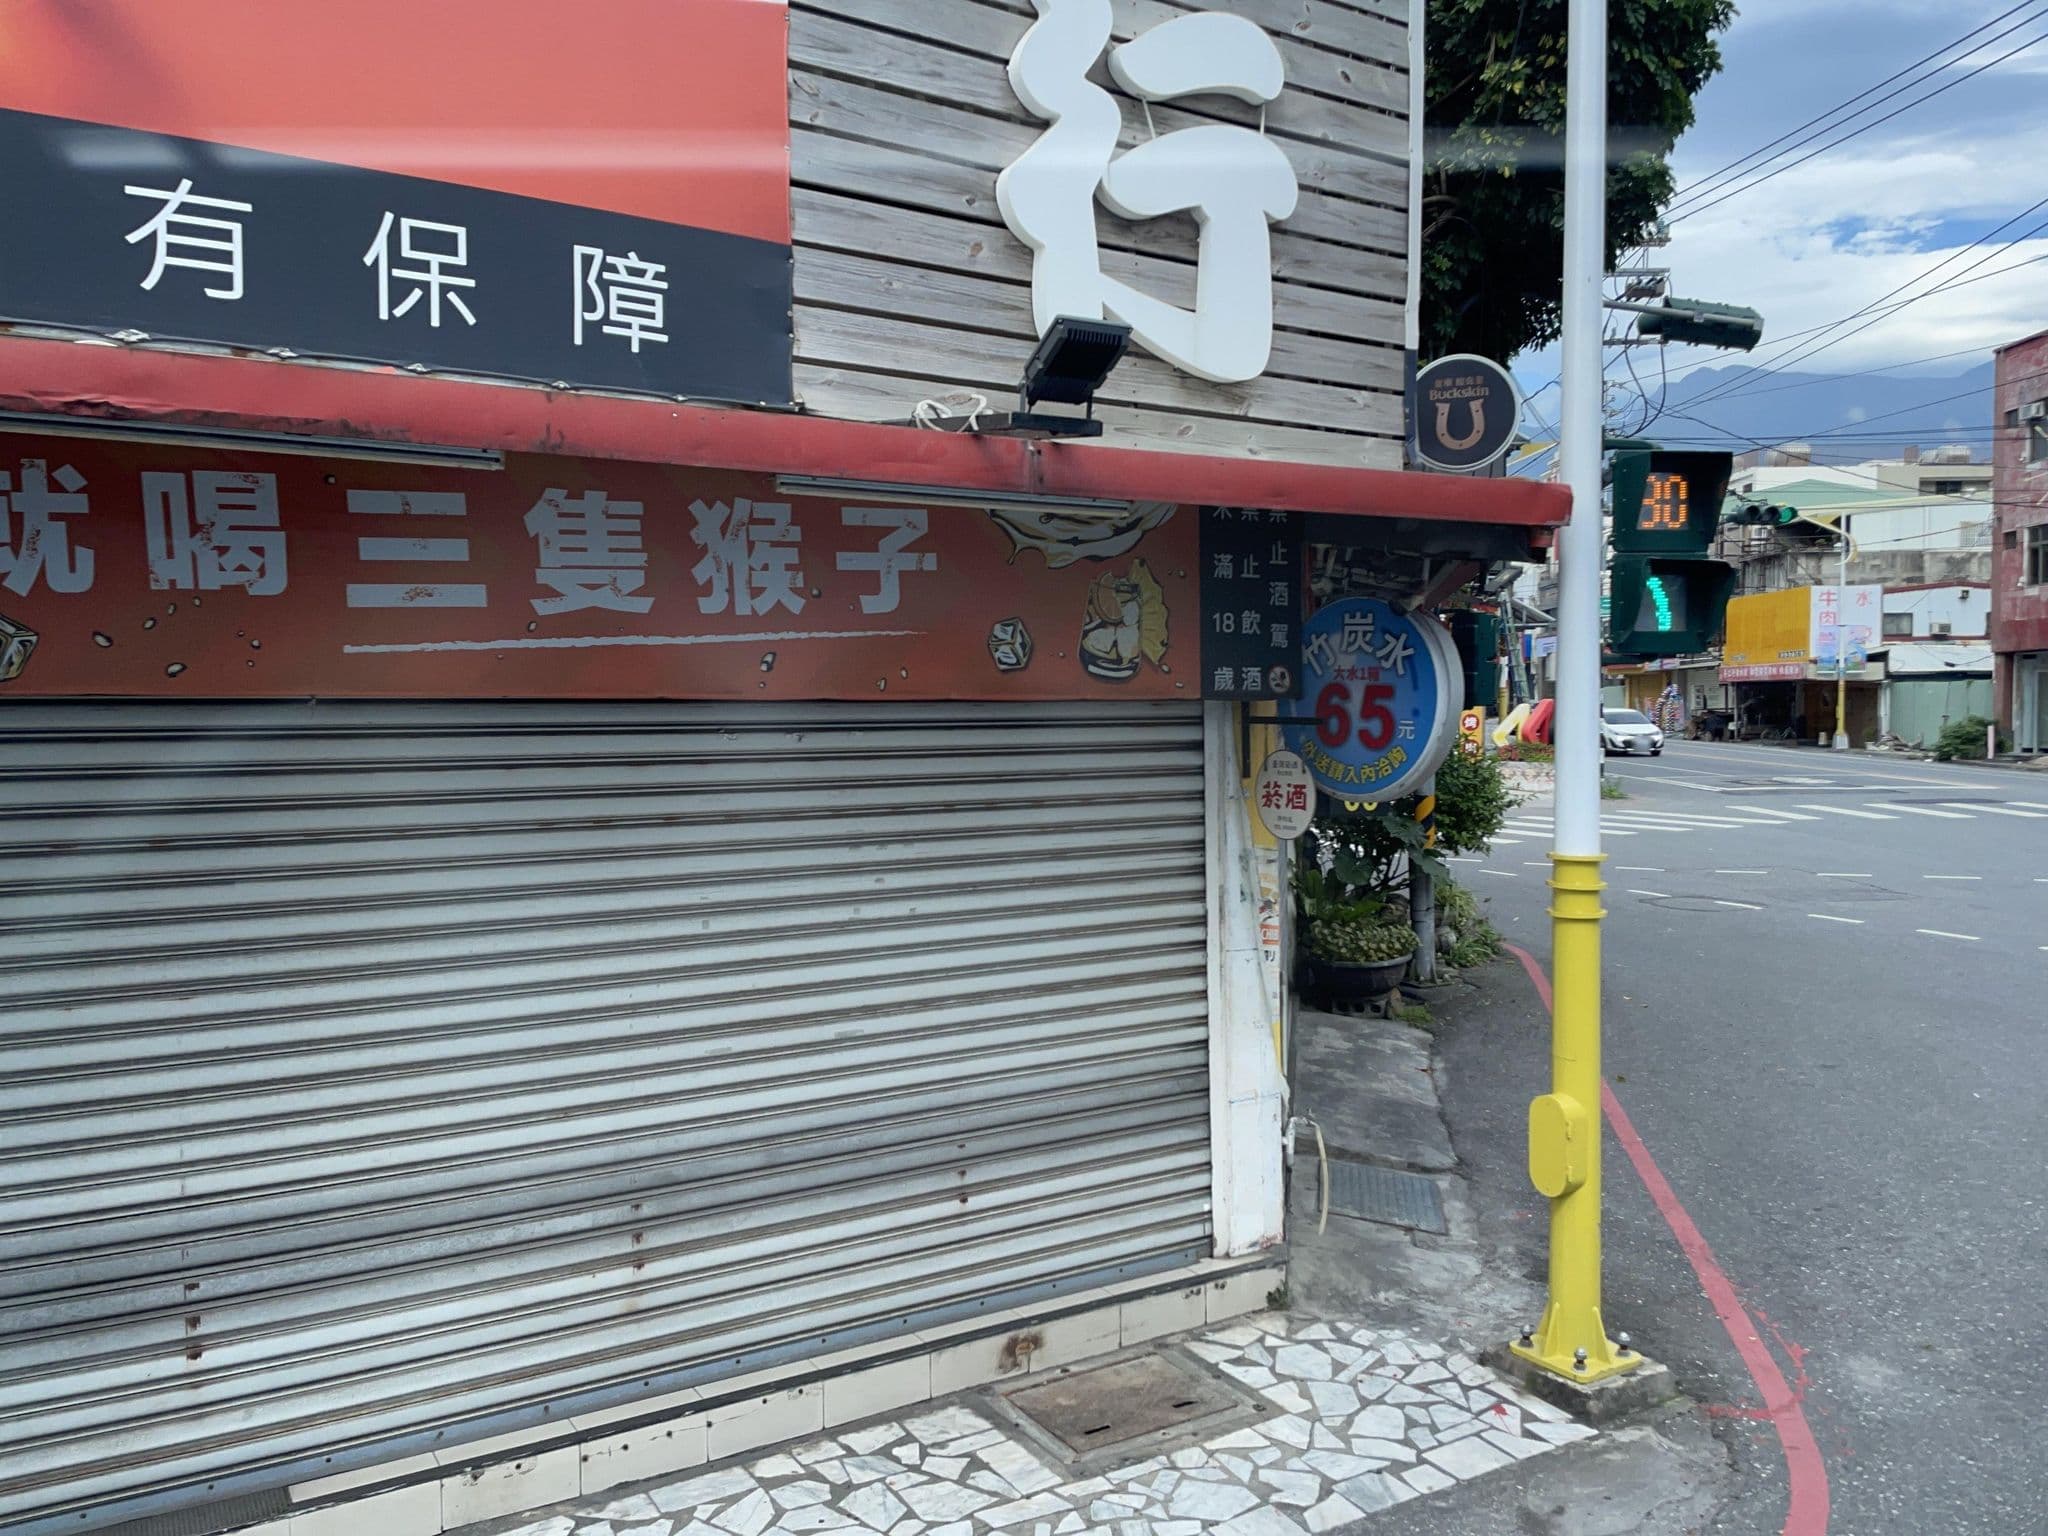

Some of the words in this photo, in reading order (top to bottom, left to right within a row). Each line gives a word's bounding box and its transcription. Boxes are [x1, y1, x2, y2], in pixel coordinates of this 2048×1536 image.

[996, 0, 1299, 383] 行
[123, 178, 669, 353] 有保障
[1302, 611, 1415, 676] 竹炭水
[1316, 682, 1396, 749] 65
[1398, 720, 1416, 740] 元
[1261, 781, 1307, 811] 菸酒
